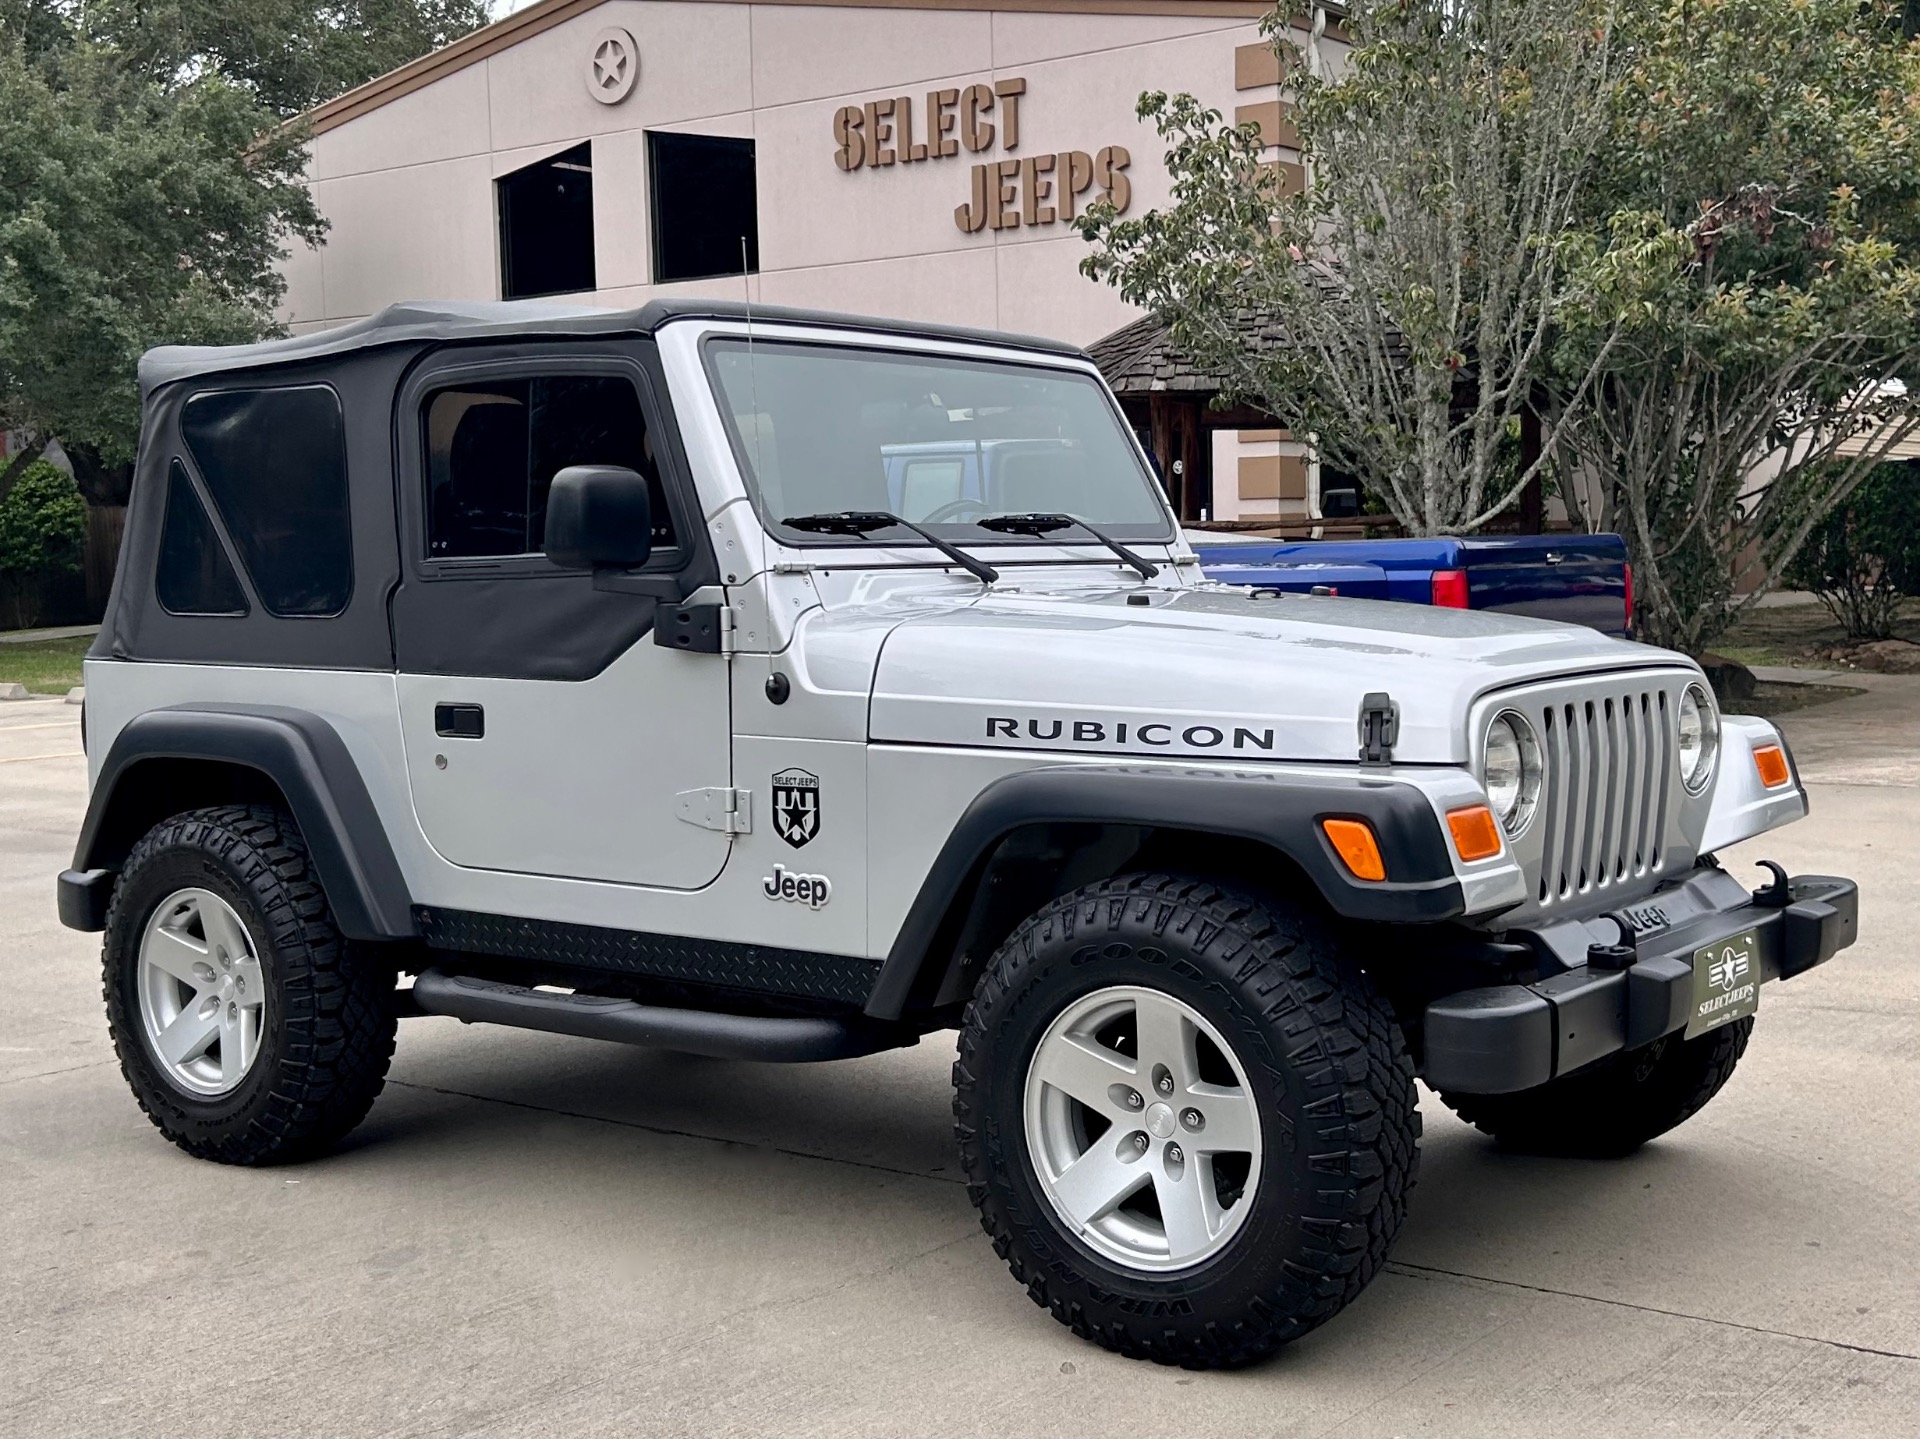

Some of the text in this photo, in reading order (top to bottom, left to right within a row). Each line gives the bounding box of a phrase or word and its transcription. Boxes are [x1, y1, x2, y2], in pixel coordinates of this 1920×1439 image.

[833, 77, 1026, 171] SELECT
[954, 146, 1131, 233] JEEPS
[986, 717, 1274, 750] RUBICON
[774, 776, 817, 787] SELECT JEEPS
[764, 867, 828, 908] Jeep
[1623, 905, 1671, 932] Jeep
